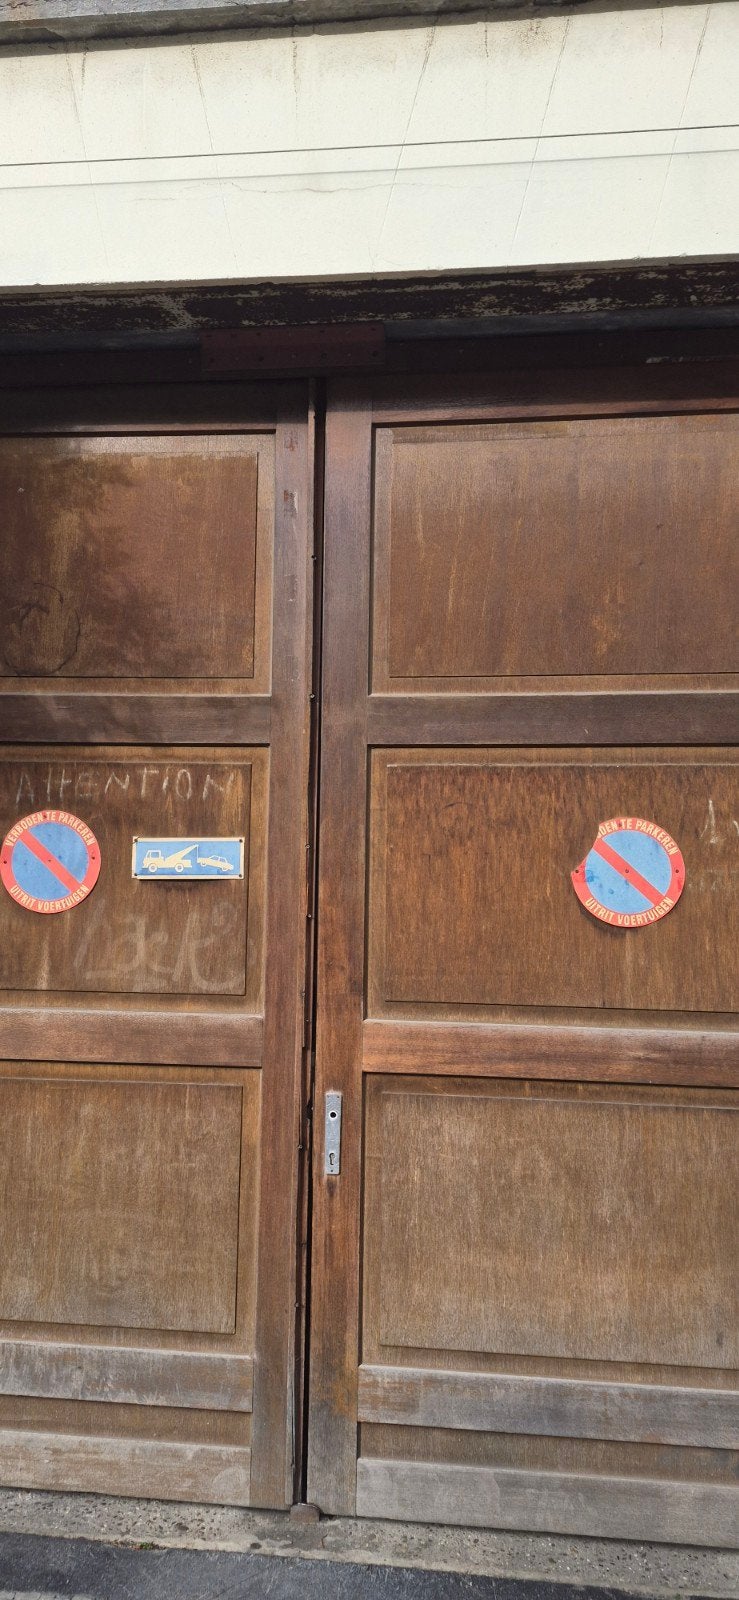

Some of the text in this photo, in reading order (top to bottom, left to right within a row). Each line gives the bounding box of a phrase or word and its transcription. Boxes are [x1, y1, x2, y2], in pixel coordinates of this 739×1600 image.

[5, 811, 96, 846] VERBODEN TE PARKEREN
[621, 818, 633, 829] TE
[635, 819, 678, 855] PARKEREN
[10, 884, 90, 911] UITRIT VOERTUIGEN
[585, 897, 674, 926] UITRIT VOERTUIGEN
